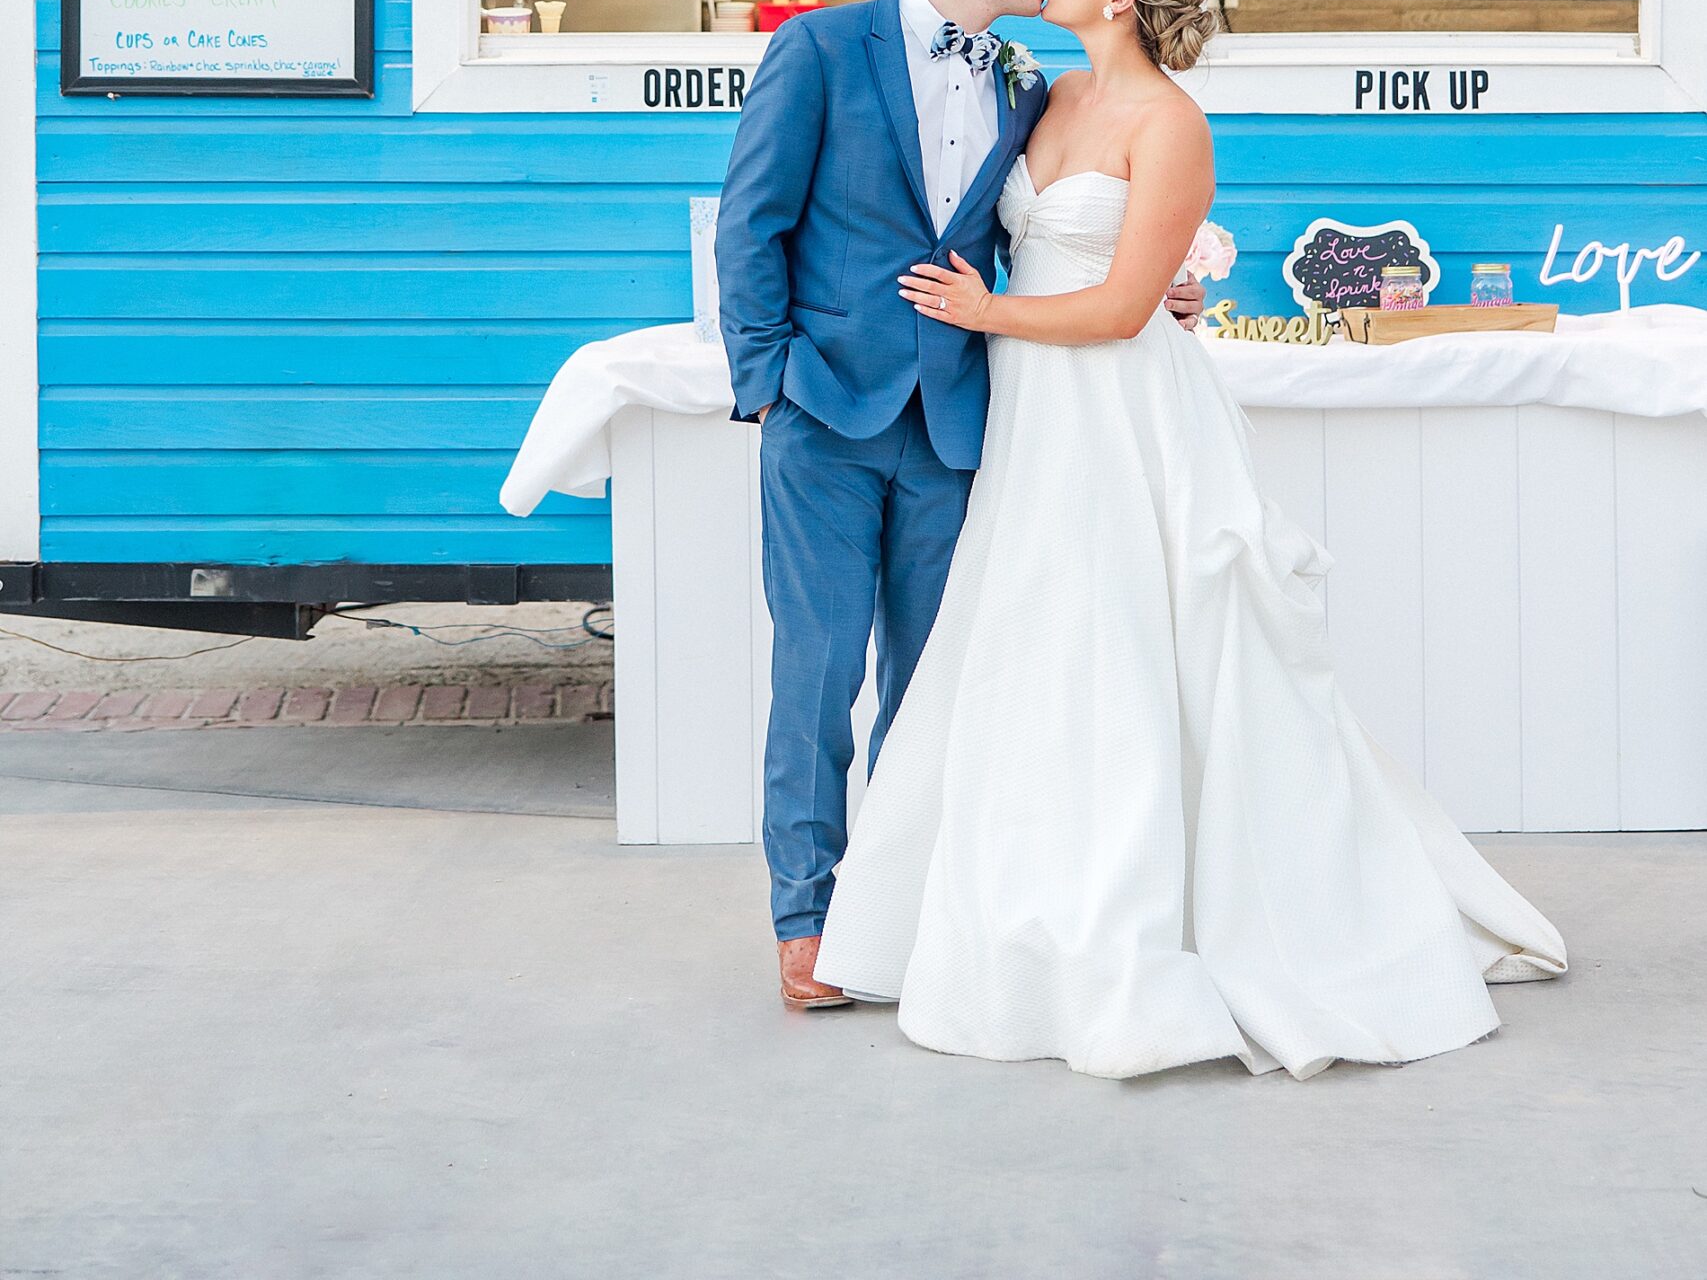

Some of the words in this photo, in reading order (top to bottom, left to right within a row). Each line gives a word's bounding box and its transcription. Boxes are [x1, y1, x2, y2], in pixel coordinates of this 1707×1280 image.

[643, 68, 745, 108] ORDER
[1355, 70, 1430, 111] PICK
[1449, 70, 1489, 110] UP
[1319, 238, 1387, 264] Love
[1540, 224, 1700, 290] Love
[1325, 275, 1381, 303] Sprink
[1204, 299, 1333, 346] Sweet
